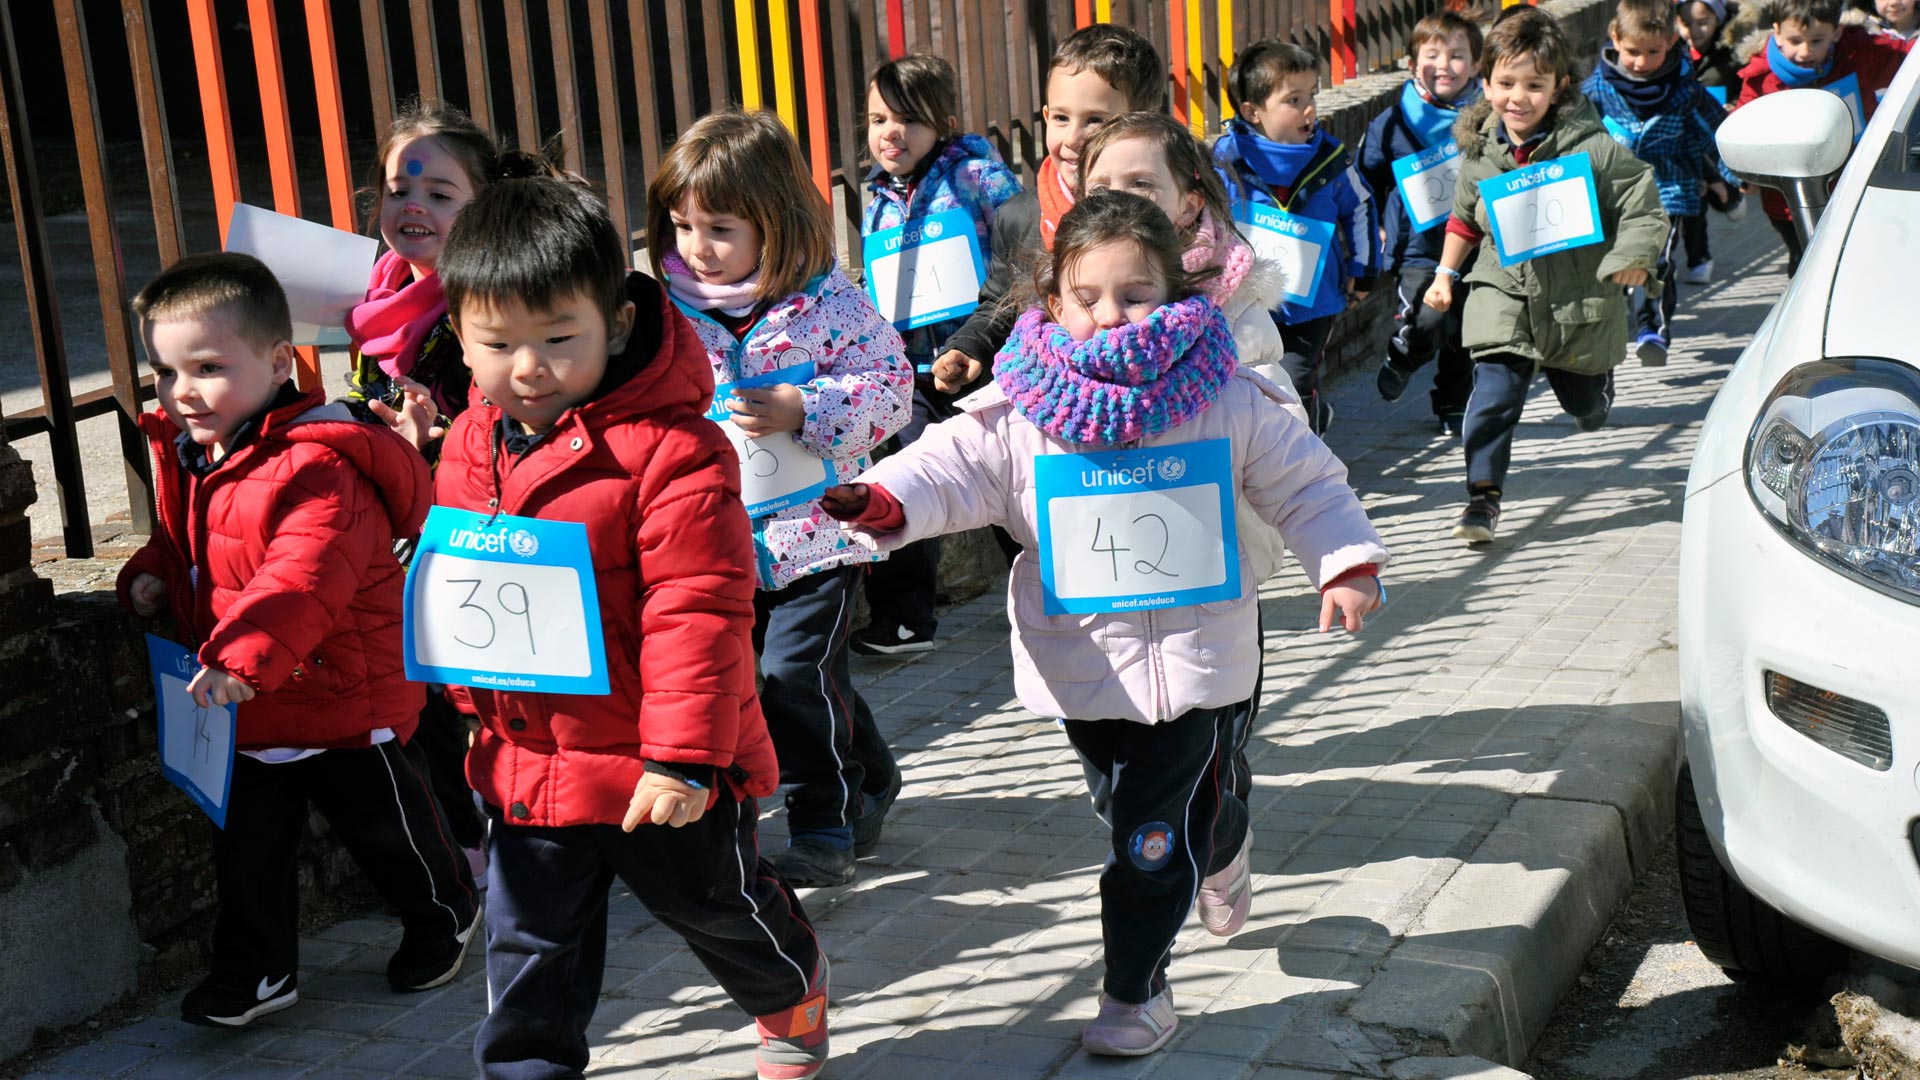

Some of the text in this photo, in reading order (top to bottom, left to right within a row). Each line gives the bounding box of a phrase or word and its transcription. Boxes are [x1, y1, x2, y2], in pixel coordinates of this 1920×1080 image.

[1411, 146, 1445, 172] unicef
[1505, 167, 1548, 192] unicef
[1254, 212, 1294, 233] unicef
[1527, 198, 1564, 234] 20
[884, 224, 925, 251] unicef
[906, 264, 942, 299] 21
[739, 438, 779, 478] 5
[1081, 459, 1155, 488] unicef
[449, 526, 509, 554] unicef
[1090, 513, 1180, 582] 42
[1111, 596, 1175, 609] unicef.es/educa
[446, 579, 537, 655] 39
[471, 674, 537, 688] unicef.es/educa
